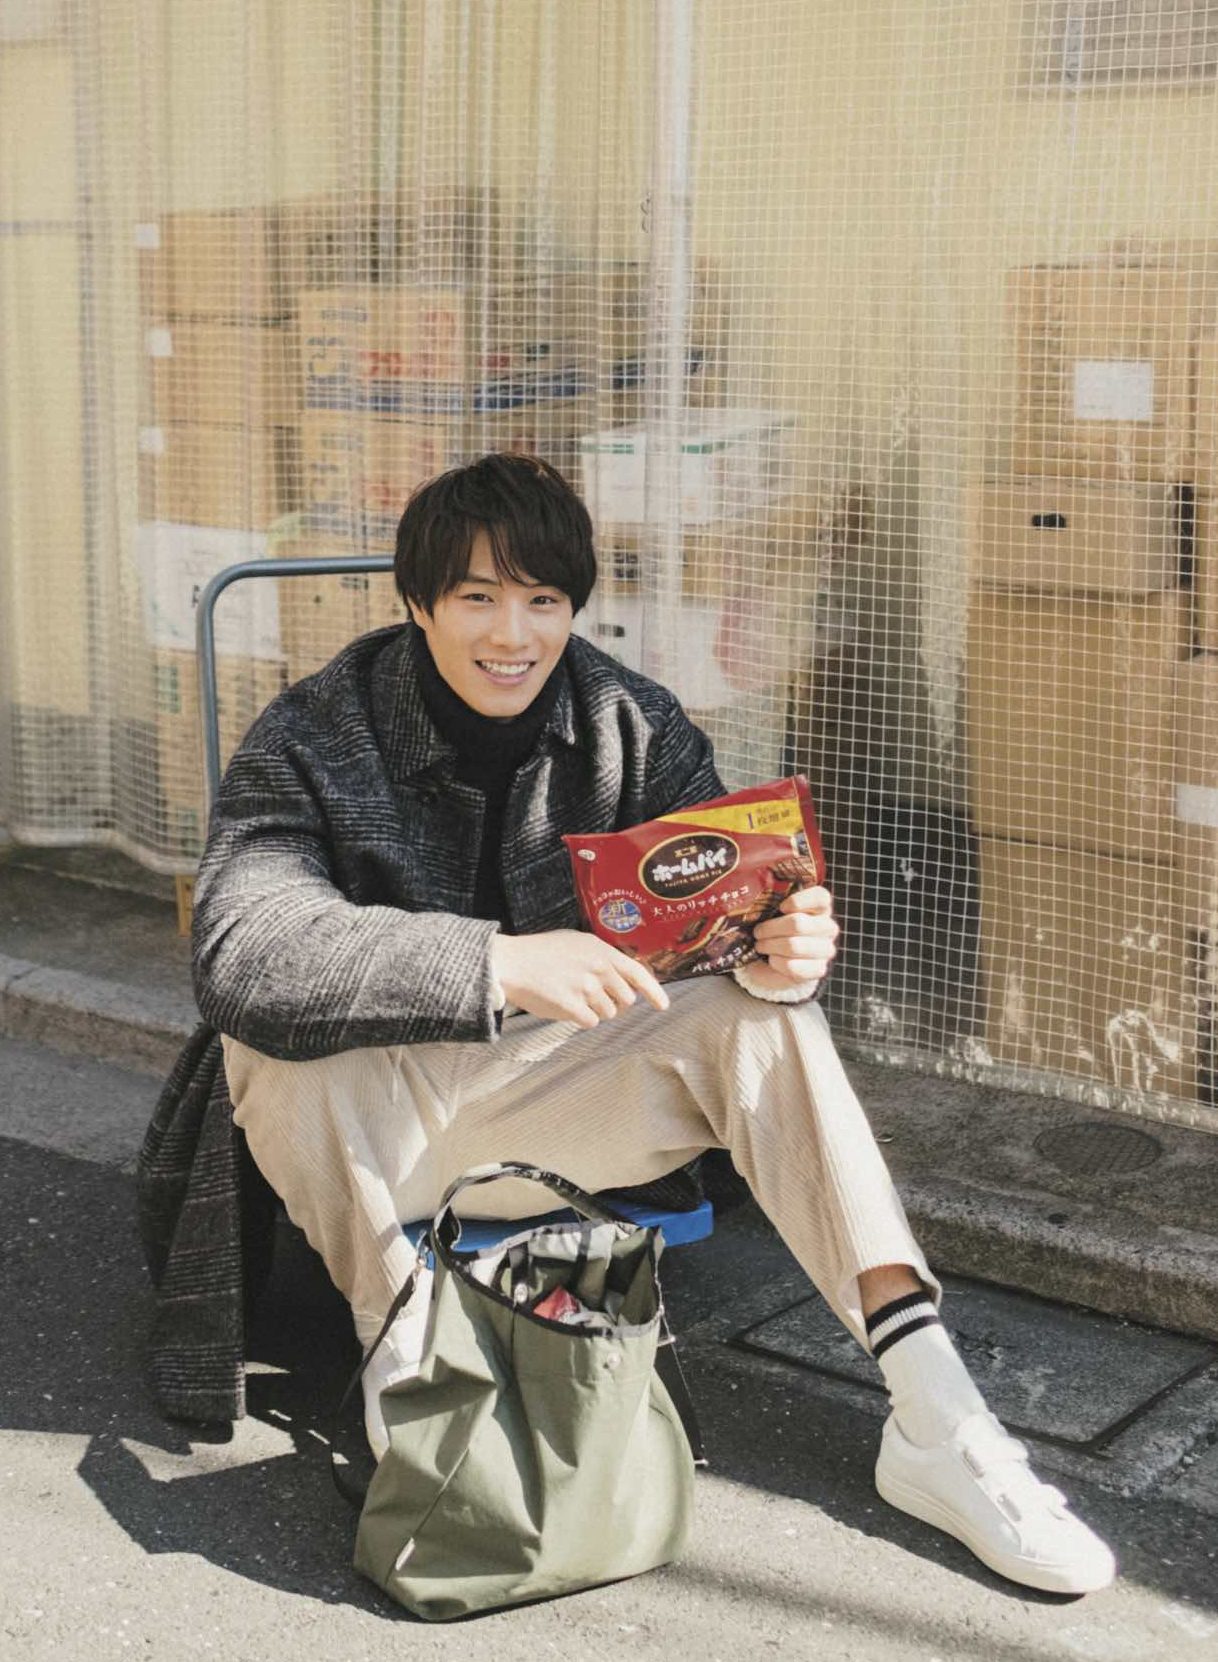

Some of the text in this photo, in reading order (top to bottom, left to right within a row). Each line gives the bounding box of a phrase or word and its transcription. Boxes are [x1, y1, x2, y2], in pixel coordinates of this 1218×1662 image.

[652, 847, 727, 882] ホームパイ
